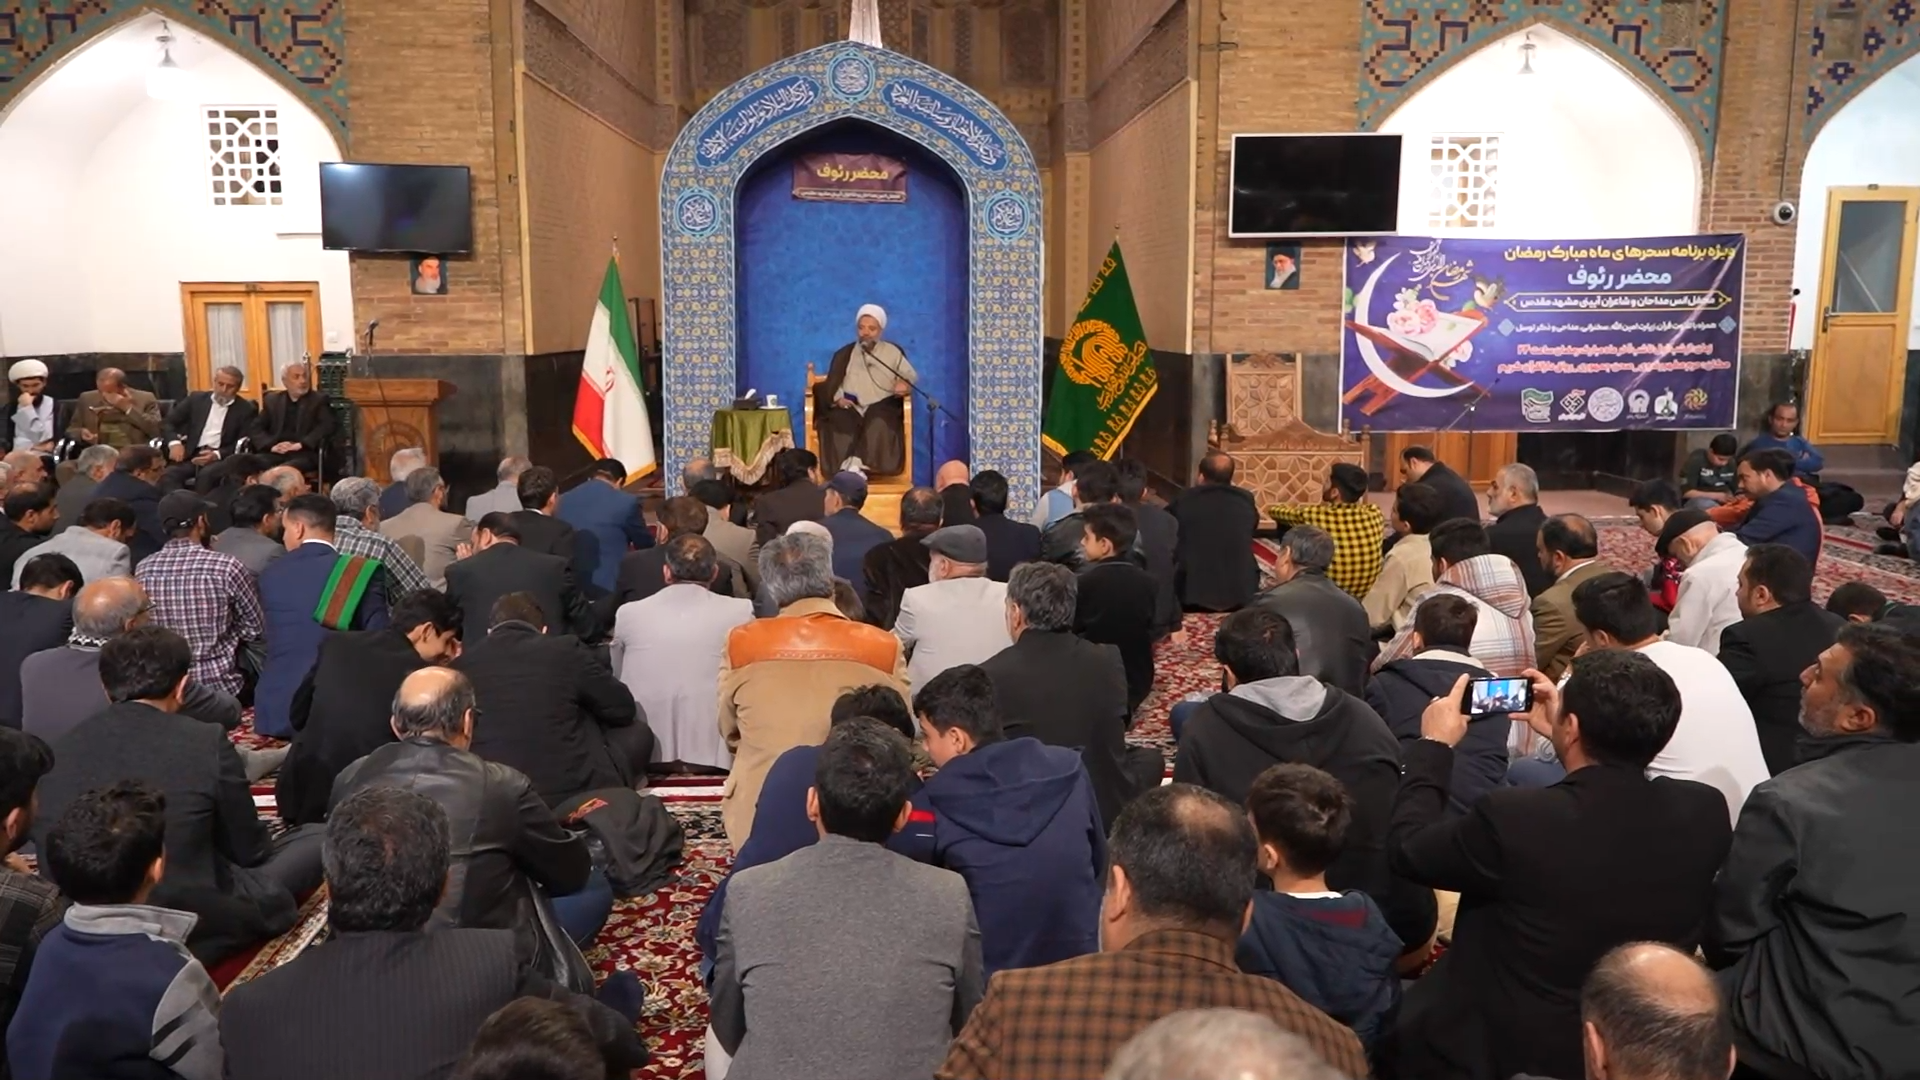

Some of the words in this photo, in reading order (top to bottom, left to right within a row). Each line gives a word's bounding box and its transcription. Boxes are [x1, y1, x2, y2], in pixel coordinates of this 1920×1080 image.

[816, 163, 849, 181] رئوف
[849, 167, 889, 182] محضر
[1504, 245, 1546, 262] رمضان
[1547, 245, 1588, 262] مبارک
[1589, 245, 1611, 258] ماه
[1611, 245, 1670, 261] سحرهای
[1671, 244, 1707, 260] برنامه
[1708, 244, 1735, 260] ویژه
[1567, 264, 1614, 290] رئوف
[1615, 268, 1671, 290] محضر
[1520, 297, 1551, 308] مقدس
[1552, 297, 1578, 308] مشهد
[1601, 296, 1630, 308] شاعران
[1631, 299, 1636, 308] و
[1637, 296, 1670, 307] مداحان
